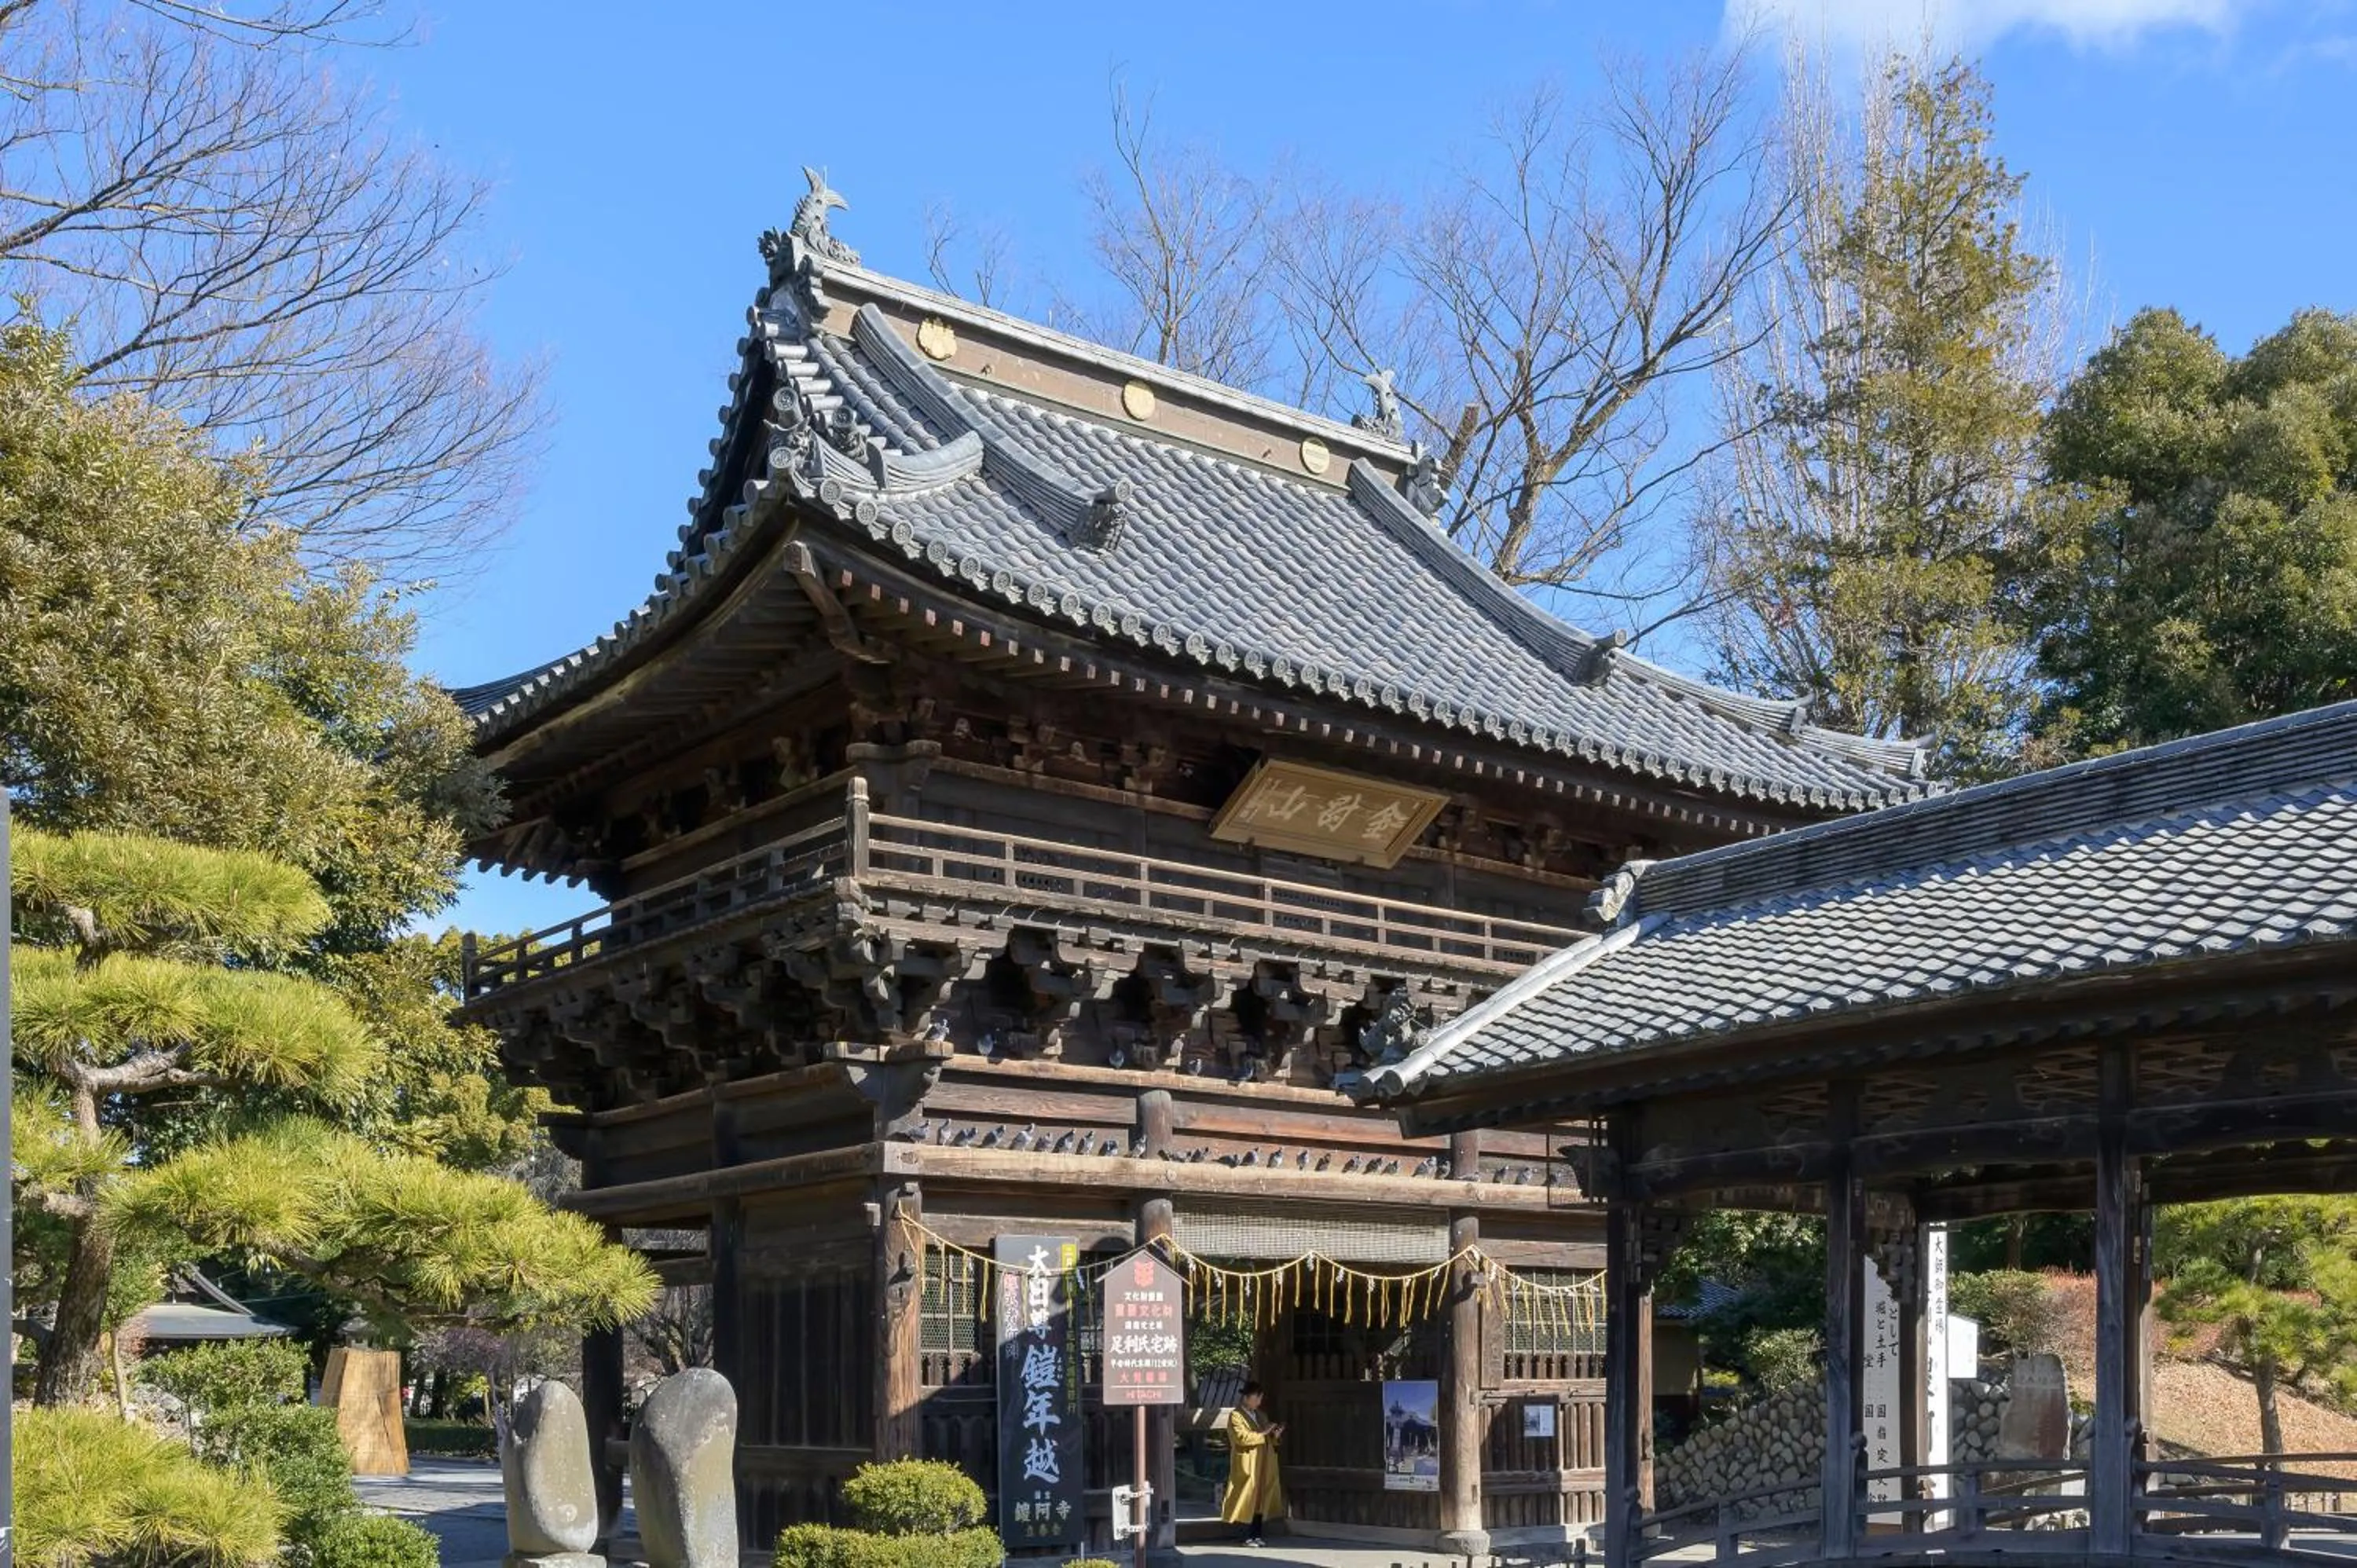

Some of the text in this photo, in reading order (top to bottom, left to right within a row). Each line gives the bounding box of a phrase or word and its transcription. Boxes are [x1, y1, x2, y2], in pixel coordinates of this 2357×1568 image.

[1109, 1334, 1178, 1354] 足利氏宅跡
[1125, 1390, 1163, 1401] HITACHI
[1021, 1344, 1061, 1484] 鎧年越
